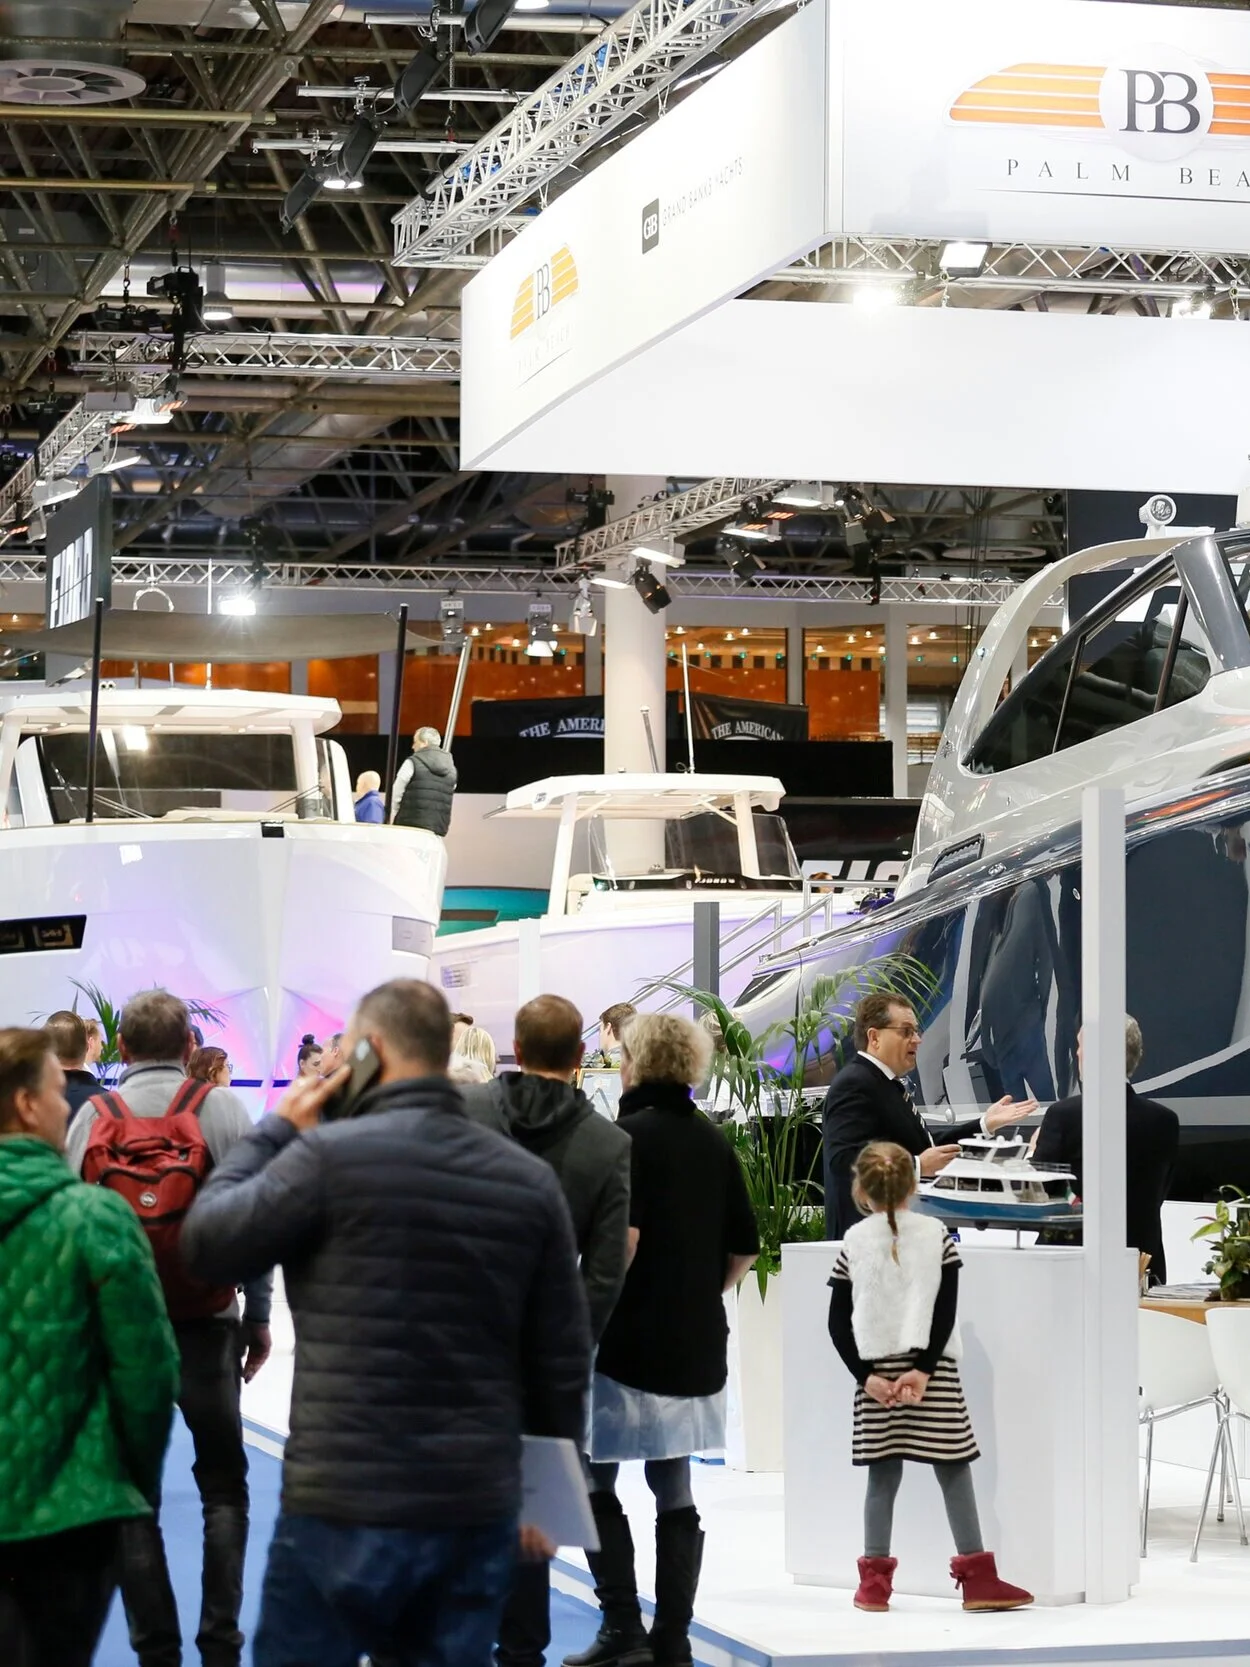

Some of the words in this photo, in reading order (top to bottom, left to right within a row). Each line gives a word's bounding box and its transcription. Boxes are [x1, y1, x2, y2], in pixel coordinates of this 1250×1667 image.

[1119, 69, 1200, 134] PB
[1006, 158, 1131, 183] PALM
[643, 212, 658, 240] GB
[715, 156, 744, 188] ACHTS
[519, 722, 551, 738] THE
[711, 722, 732, 740] THE
